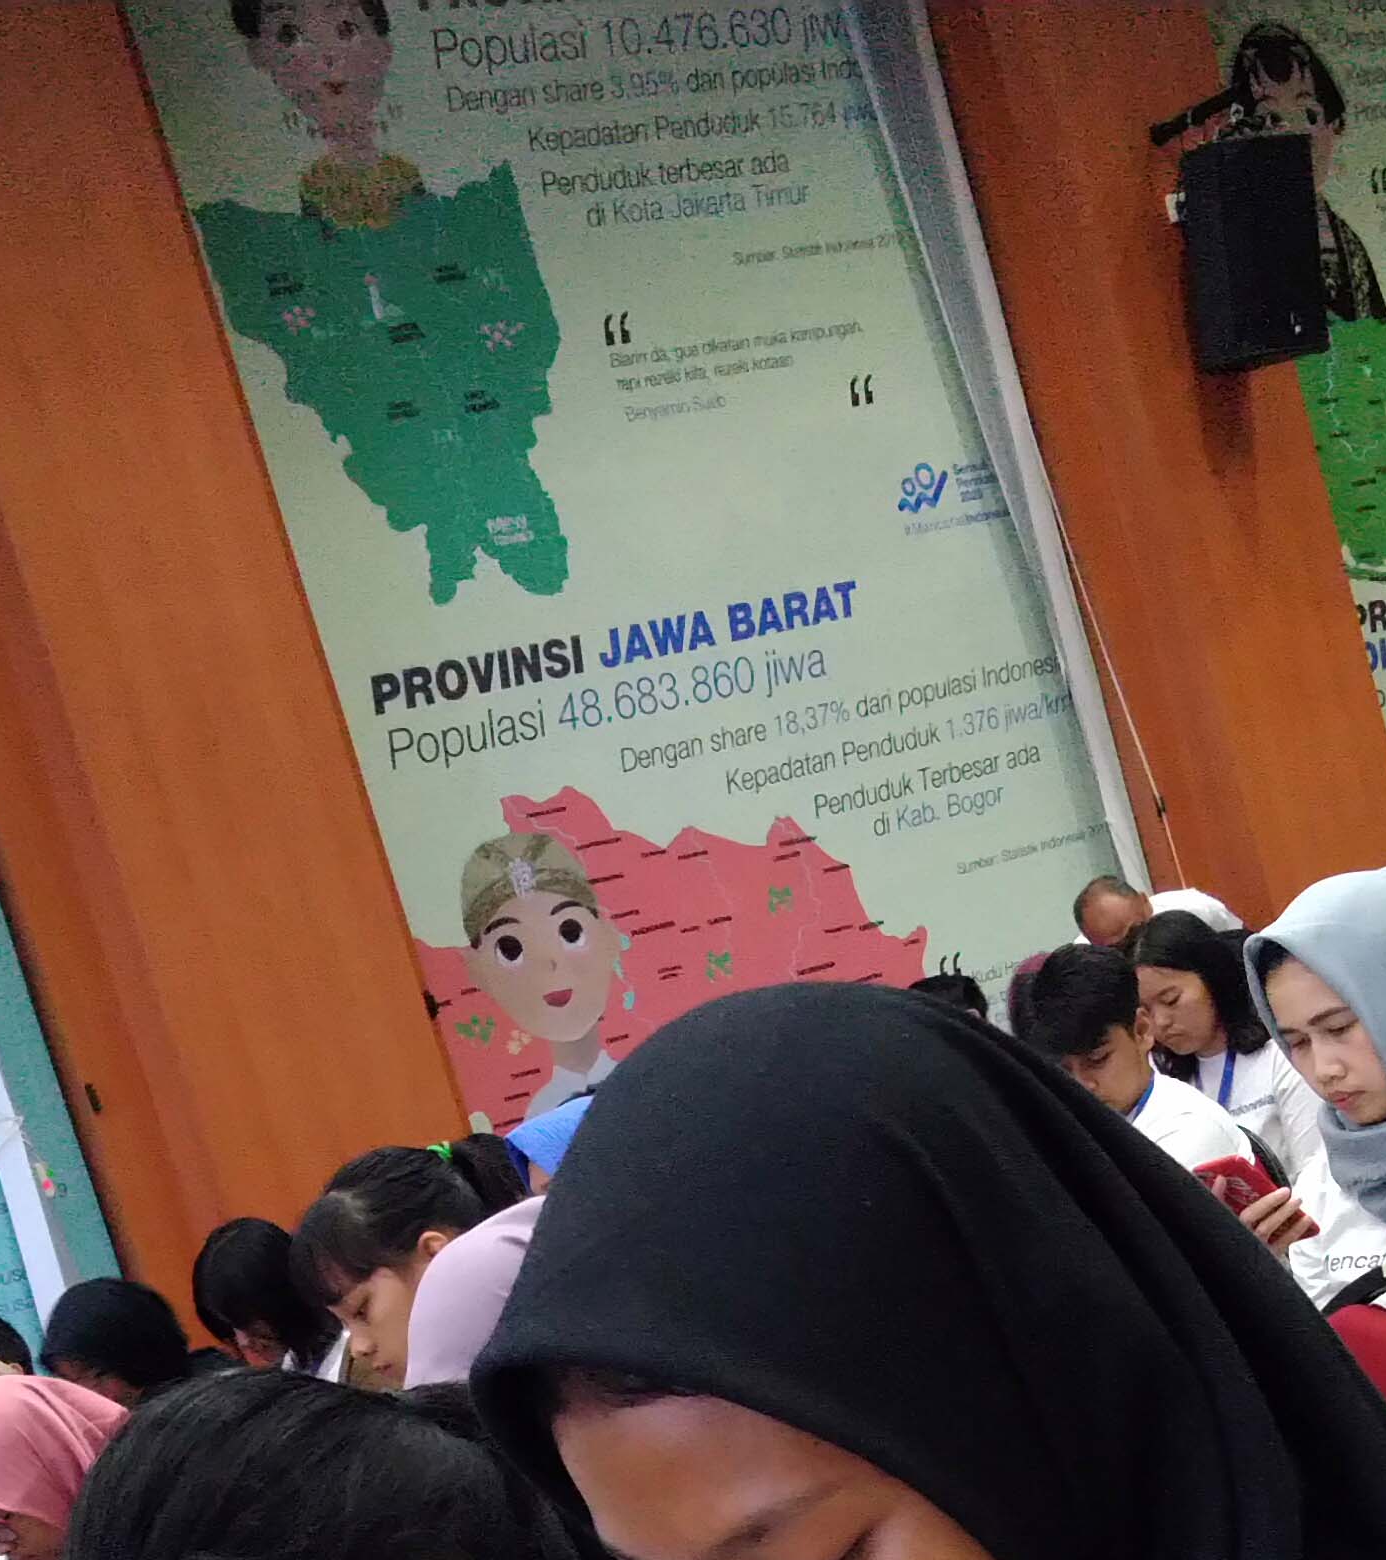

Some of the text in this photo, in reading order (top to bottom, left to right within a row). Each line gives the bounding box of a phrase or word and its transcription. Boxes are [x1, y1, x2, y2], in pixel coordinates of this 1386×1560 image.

[430, 19, 589, 76] Populasi
[602, 6, 791, 57] 10.476.630
[446, 82, 537, 116] Dengan
[542, 72, 606, 106] share
[686, 65, 726, 95] dari
[527, 121, 650, 156] Kepadatan
[653, 109, 762, 142] Penduduk
[540, 149, 790, 197] Penduduk terbesar ada
[585, 182, 812, 228] di Kota Jakarta Timur
[370, 580, 858, 717] PROVINSI JAWA BARAT
[387, 647, 827, 771] Populasi 48.683.860 jiwa
[620, 733, 704, 773] Dengan
[710, 720, 767, 754] share
[774, 701, 851, 740] 18,37%
[856, 691, 893, 721] dari
[898, 668, 979, 714] populasi
[725, 749, 837, 795] Kepadatan
[842, 726, 942, 766] Penduduk
[945, 706, 999, 740] 1.376
[814, 742, 1042, 820] Penduduk Terbesar ada
[872, 784, 1004, 838] di Kab. Bogor
